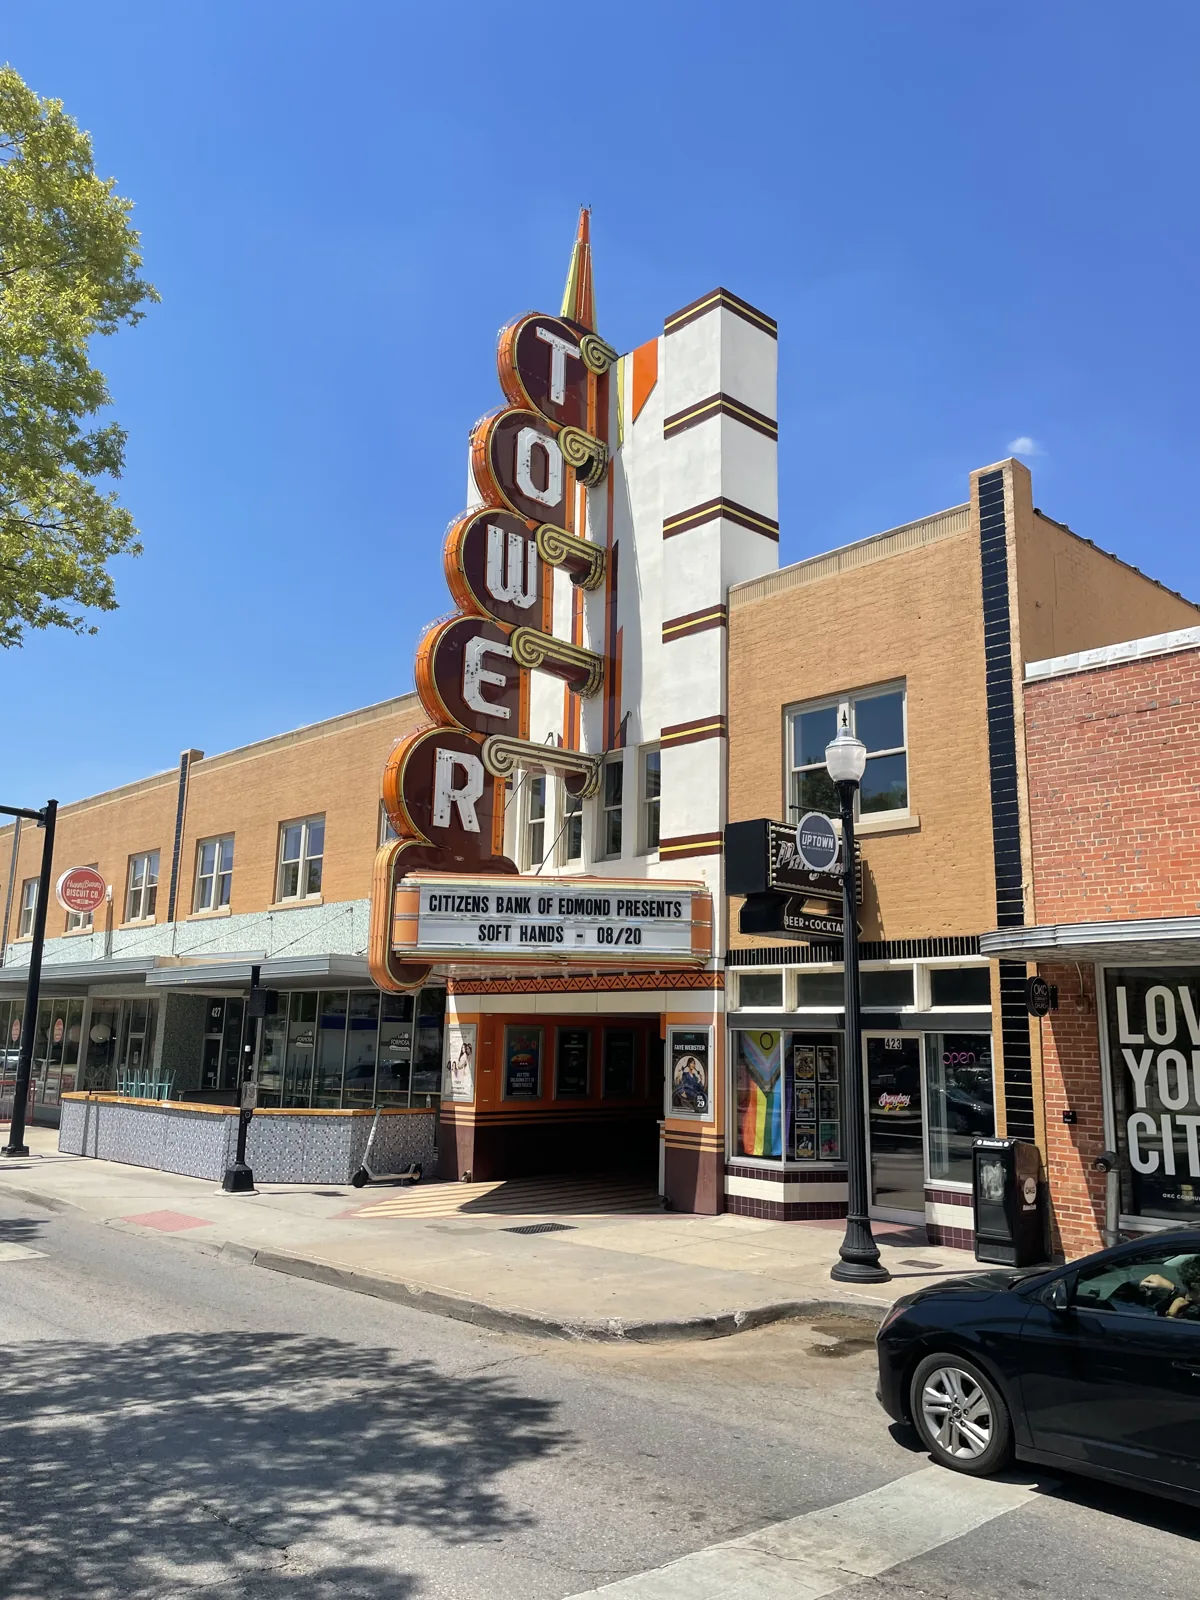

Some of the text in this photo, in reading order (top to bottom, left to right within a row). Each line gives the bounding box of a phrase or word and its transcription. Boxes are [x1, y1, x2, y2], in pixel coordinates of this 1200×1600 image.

[432, 326, 581, 833] TOWER
[801, 833, 835, 849] UPTOWN
[66, 888, 101, 899] BISCUIT CO.
[429, 894, 682, 919] CITIZENS BANK OF EDMOND PRESENTS
[784, 915, 844, 933] BEER COCKTAI
[478, 924, 512, 942] SOFT
[519, 925, 564, 943] HANDS
[597, 926, 642, 945] 08/20
[1033, 983, 1048, 996] OKC
[211, 1007, 222, 1018] 427
[390, 1038, 410, 1046] FORMOSA
[885, 1039, 901, 1049] 423
[1121, 1048, 1200, 1111] YO
[696, 1100, 705, 1108] 29
[1126, 1112, 1200, 1178] CIT
